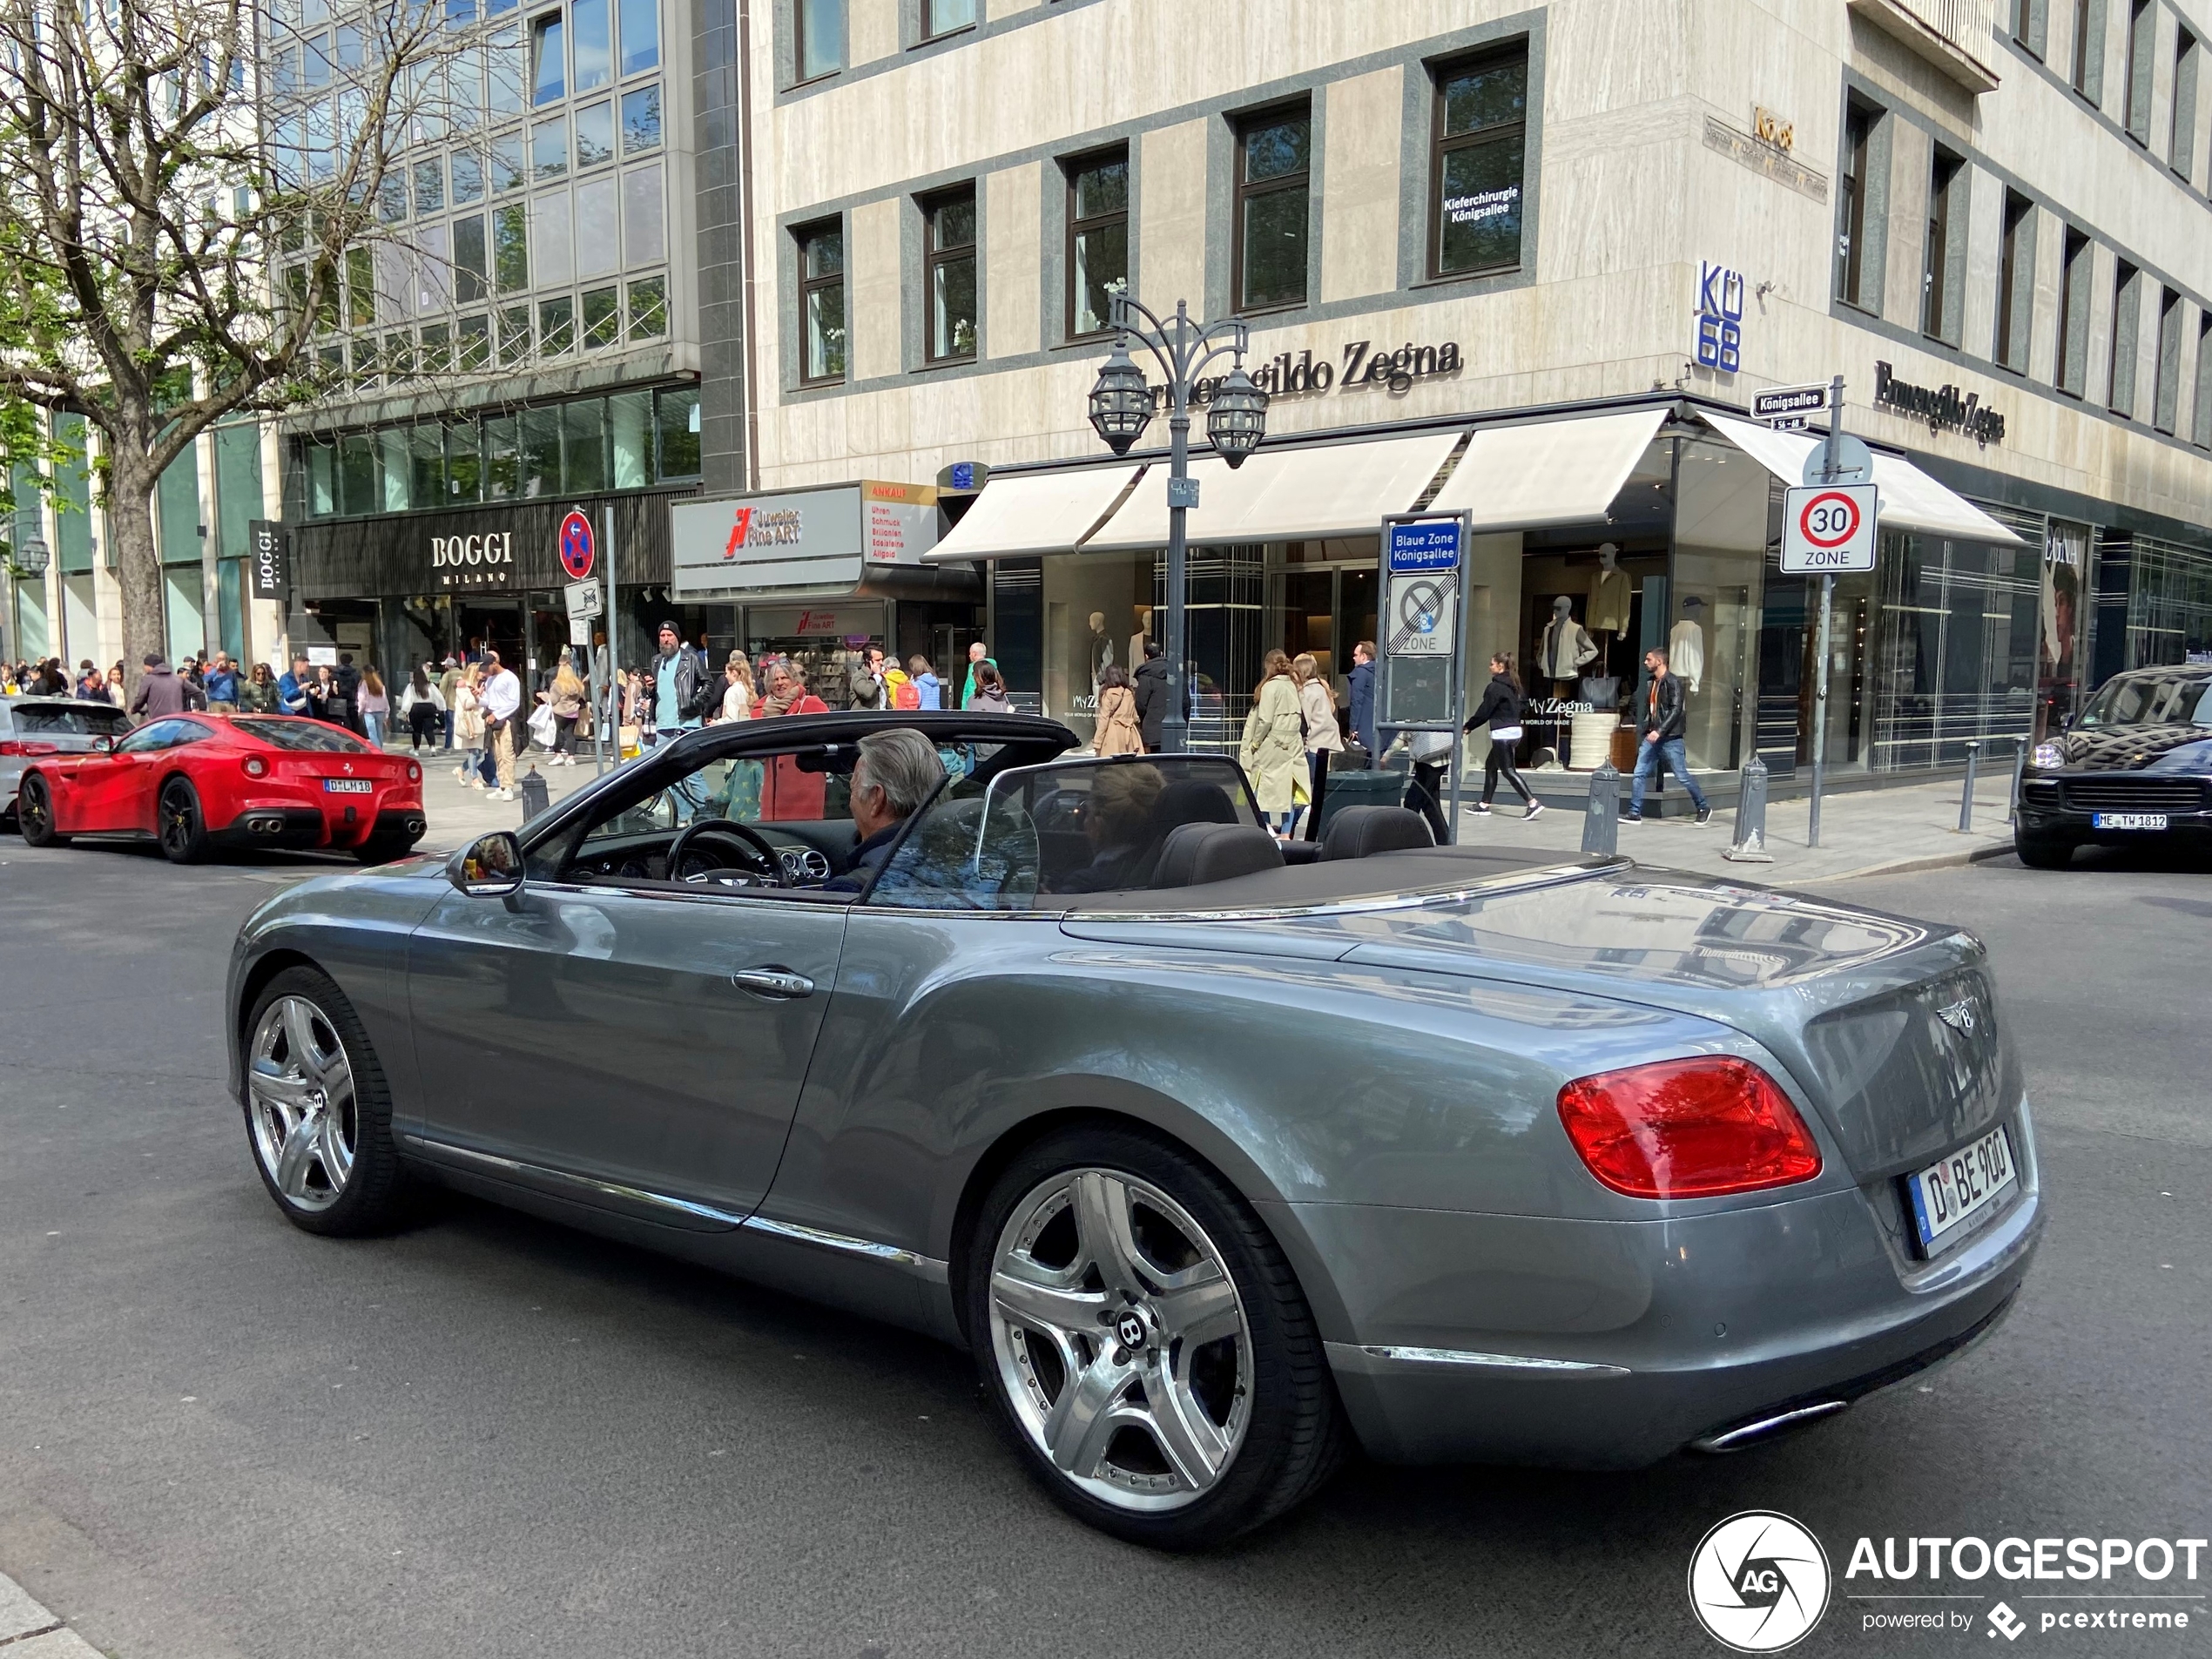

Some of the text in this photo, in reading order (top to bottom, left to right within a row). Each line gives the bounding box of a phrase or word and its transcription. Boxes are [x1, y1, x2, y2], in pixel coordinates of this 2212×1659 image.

[1444, 186, 1518, 211] Kieferchirurgie
[1451, 203, 1509, 223] Königsallee
[1698, 260, 1743, 322] KÖ
[1695, 314, 1740, 373] 68
[1340, 340, 1466, 392] Zegna
[1760, 394, 1819, 411] Königsallee
[757, 509, 800, 526] Juwelier
[872, 506, 891, 516] Uhren
[1812, 507, 1847, 533] 30
[872, 516, 901, 527] Schmuck
[749, 524, 800, 545] Fine ART
[1396, 533, 1453, 547] Blaue Zone
[430, 532, 513, 567] BOGGI
[1394, 548, 1454, 563] Königsallee
[1804, 550, 1851, 565] ZONE
[259, 530, 274, 590] BOGGI
[442, 572, 506, 585] MILANO
[1403, 637, 1436, 650] ZONE
[2100, 814, 2166, 826] ME TW 1812
[1927, 1171, 1947, 1224] D
[1952, 1150, 1982, 1209] BE
[1977, 1130, 2006, 1190] 900
